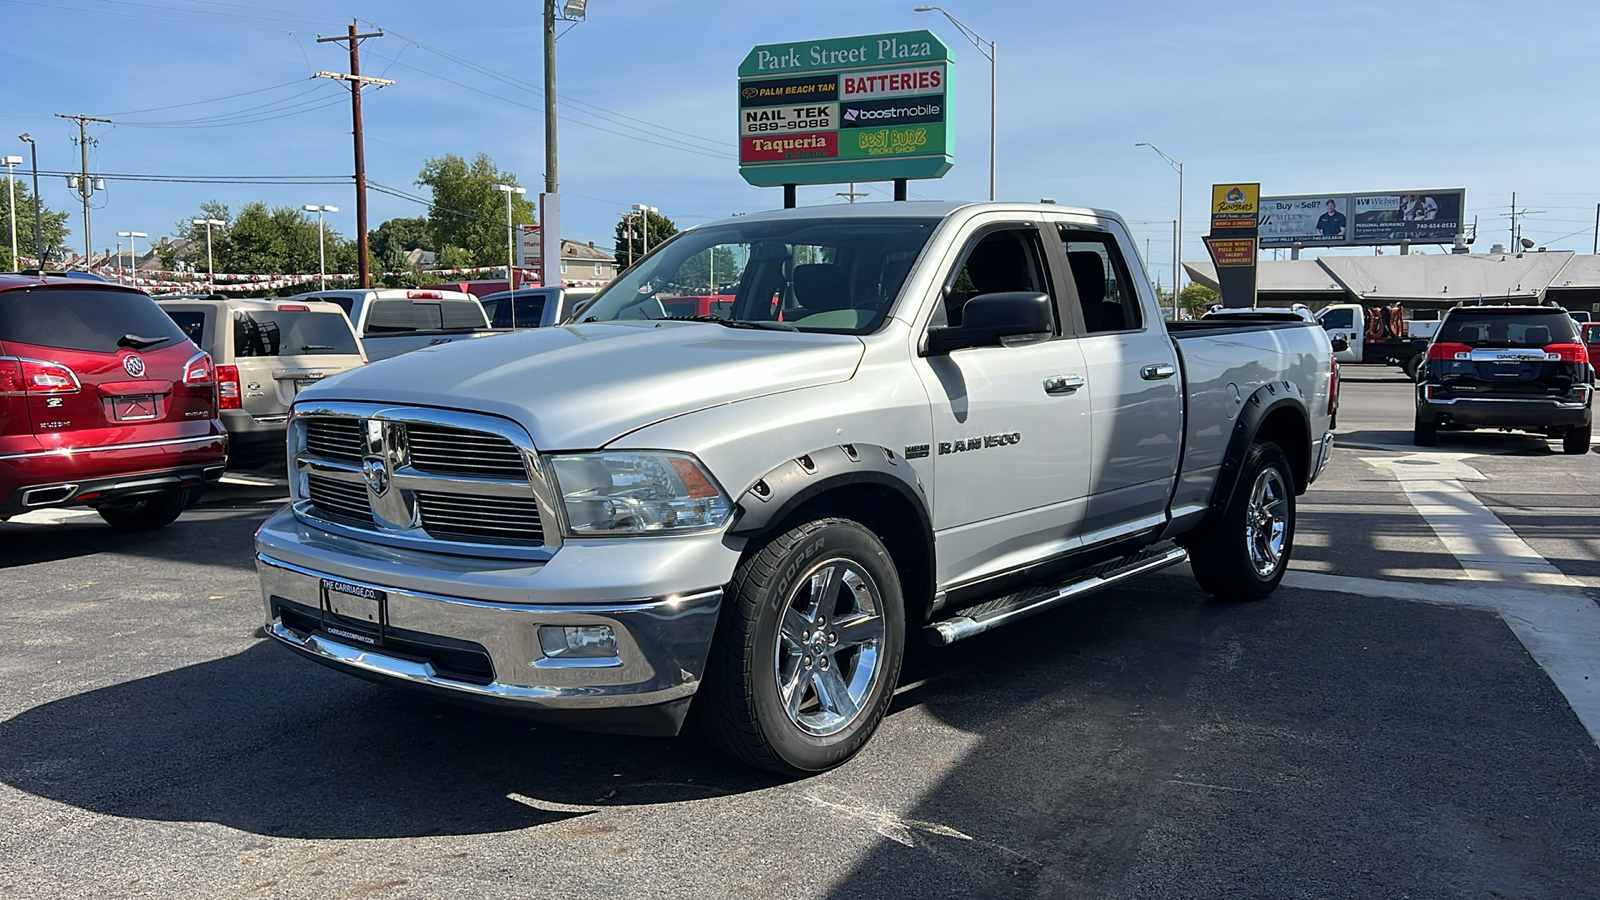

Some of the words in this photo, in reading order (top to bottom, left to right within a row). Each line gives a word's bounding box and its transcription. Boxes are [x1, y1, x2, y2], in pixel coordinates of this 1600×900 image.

[757, 47, 801, 69] Park
[810, 45, 867, 65] Street
[877, 37, 931, 59] Plaza
[845, 70, 940, 94] BATTERIES
[759, 87, 783, 96] PALM
[785, 85, 815, 94] BEACH
[817, 83, 836, 92] TAN
[746, 110, 786, 122] NAIL
[793, 106, 830, 118] TEK
[860, 104, 940, 119] boostmobile
[748, 118, 829, 132] 689-9088
[895, 145, 916, 153] SHOP
[1217, 201, 1253, 213] Roosters
[1276, 202, 1293, 210] Buy
[938, 438, 981, 455] RAM
[983, 432, 1020, 449] 1500
[771, 537, 825, 611] COOPER
[323, 580, 334, 590] THE
